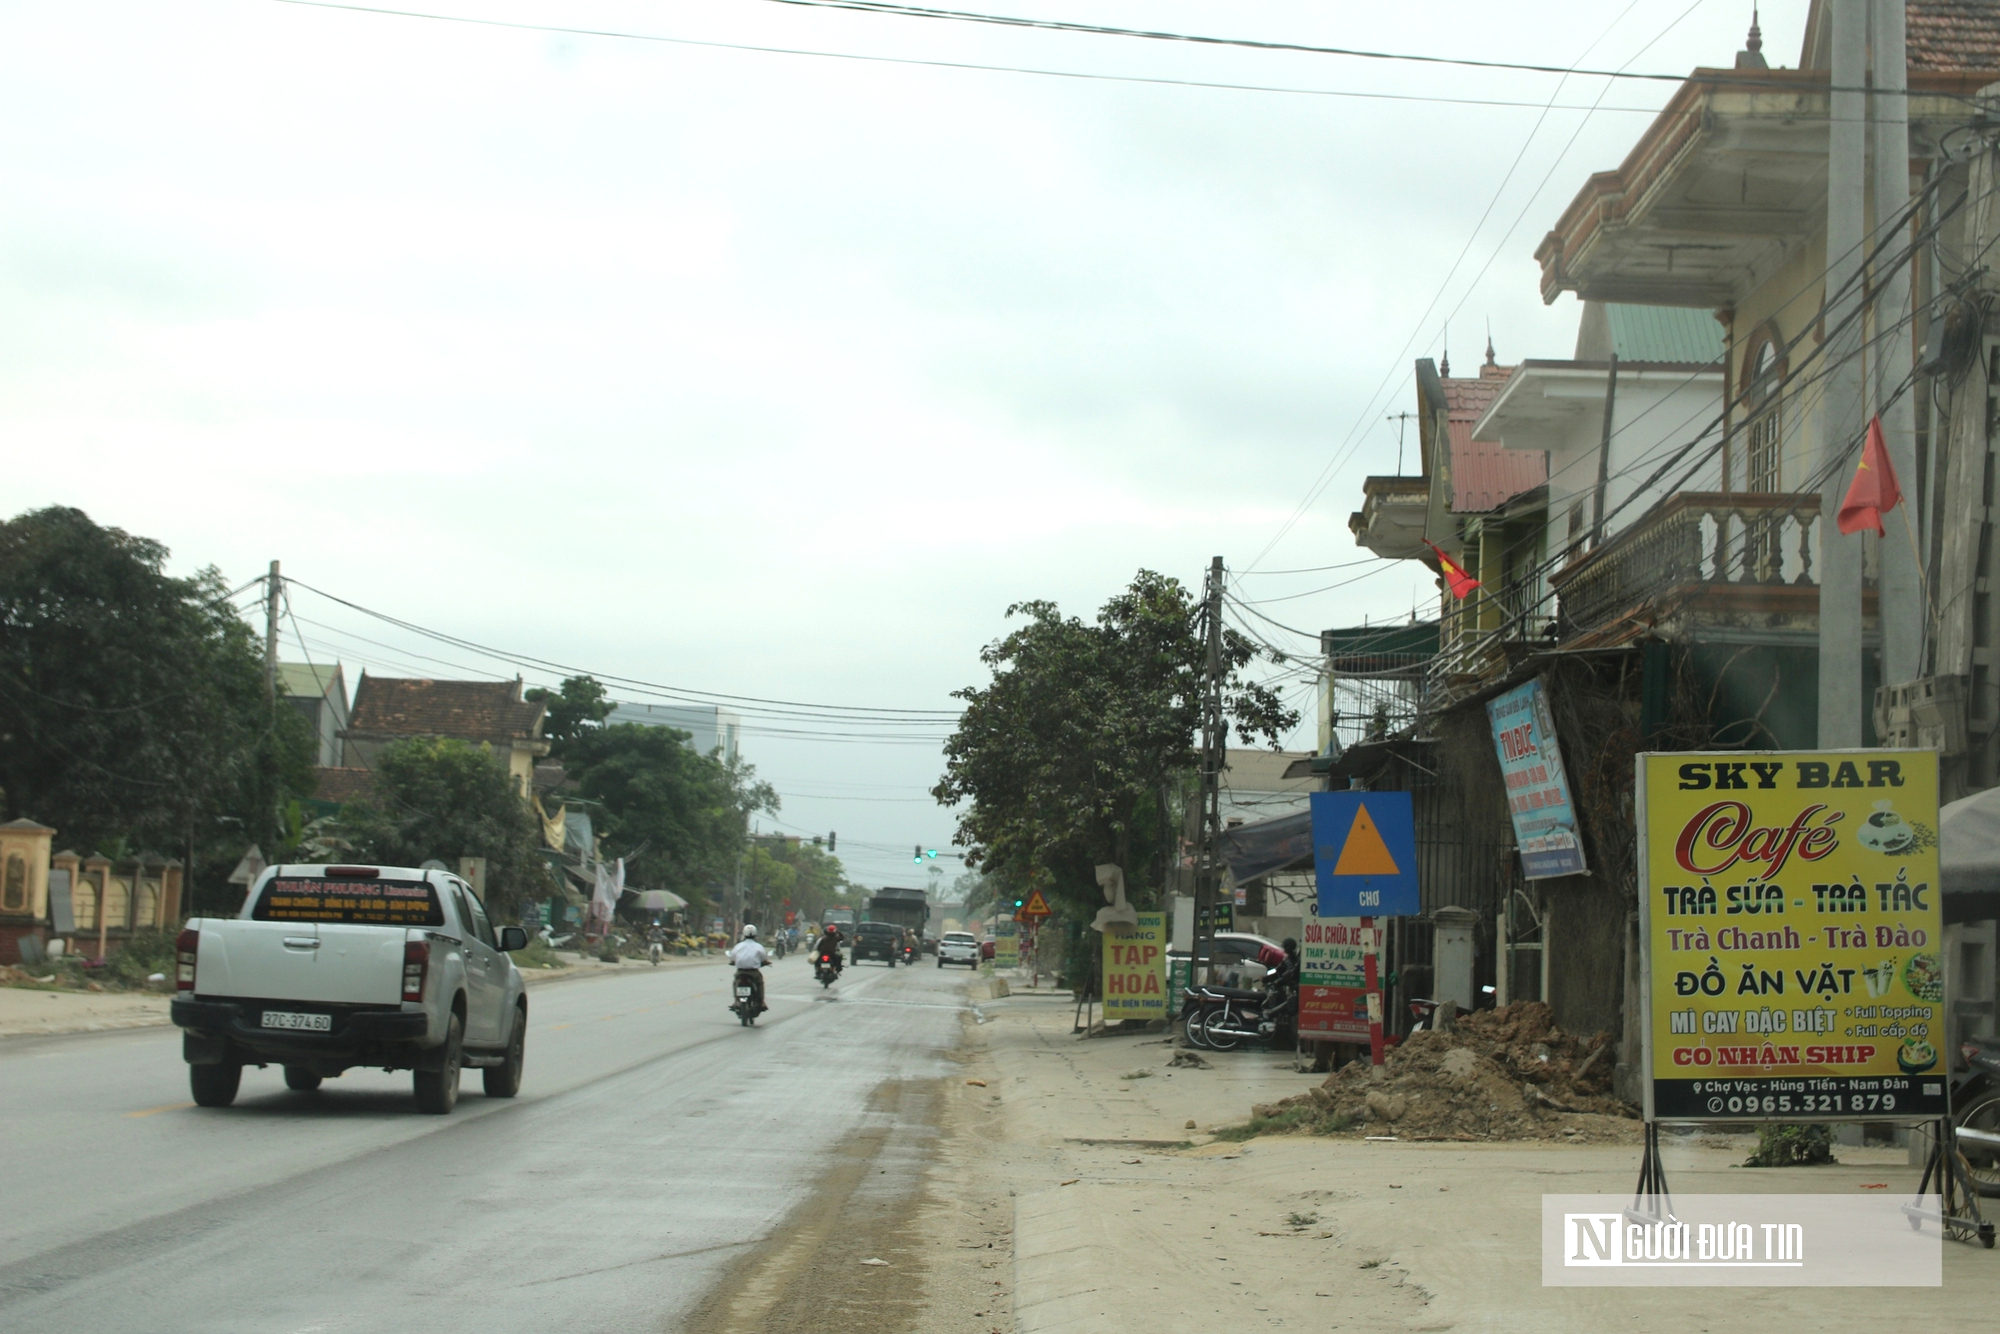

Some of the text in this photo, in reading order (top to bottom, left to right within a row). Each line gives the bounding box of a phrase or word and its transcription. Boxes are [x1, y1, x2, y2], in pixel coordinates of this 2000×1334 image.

[1679, 760, 1905, 790] SKY BAR
[1674, 800, 1845, 880] Café
[1359, 890, 1380, 906] CHỢ
[1663, 877, 1717, 915] TRÀ
[1726, 878, 1784, 914] SỮA
[1812, 875, 1867, 912] TRÀ
[1875, 867, 1928, 912] TẮC
[1305, 919, 1322, 943] SỬA
[1324, 923, 1347, 945] CHỮA
[1349, 927, 1361, 945] XE
[1667, 926, 1710, 951] Trà
[1718, 925, 1800, 950] Chanh
[1823, 924, 1868, 949] Trà
[1875, 923, 1927, 948] Đào
[1111, 945, 1158, 969] TẠP
[1108, 970, 1160, 994] HOÁ
[1674, 956, 1856, 1002] ĐỒ ĂN VẶT
[1671, 1006, 1836, 1036] MÌ CAY ĐẶC BIỆT
[1855, 1005, 1932, 1020] Full Topping
[1856, 1021, 1928, 1039] Full cấp độ
[1717, 1041, 1800, 1070] NHẬN
[1806, 1045, 1876, 1064] SHIP
[1705, 1081, 1730, 1093] Chợ
[1735, 1082, 1758, 1094] Vạc
[1770, 1080, 1805, 1093] Hùng
[1808, 1077, 1837, 1090] Tiến
[1849, 1079, 1879, 1090] Nam
